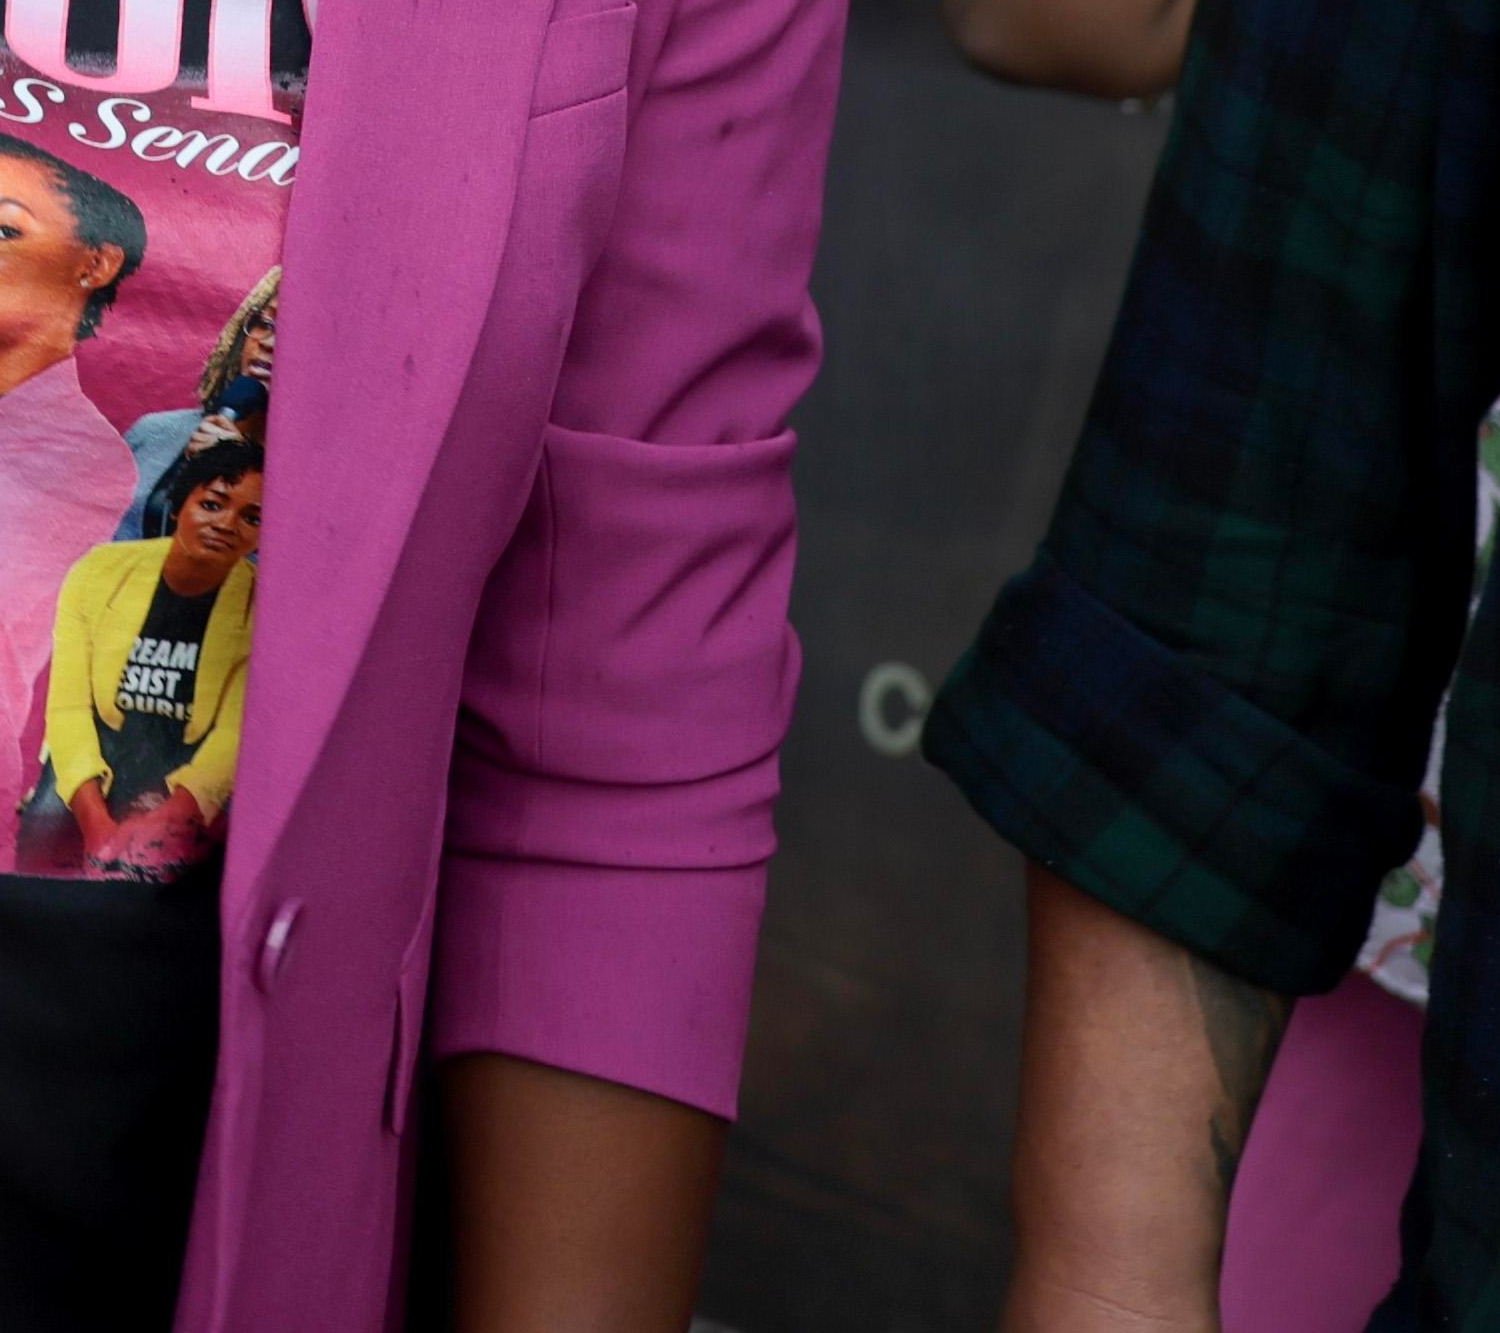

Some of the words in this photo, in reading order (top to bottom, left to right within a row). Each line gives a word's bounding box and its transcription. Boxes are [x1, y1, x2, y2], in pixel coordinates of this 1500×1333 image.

[68, 96, 300, 187] Sena
[128, 636, 200, 672] REAM
[119, 664, 182, 700] SIST
